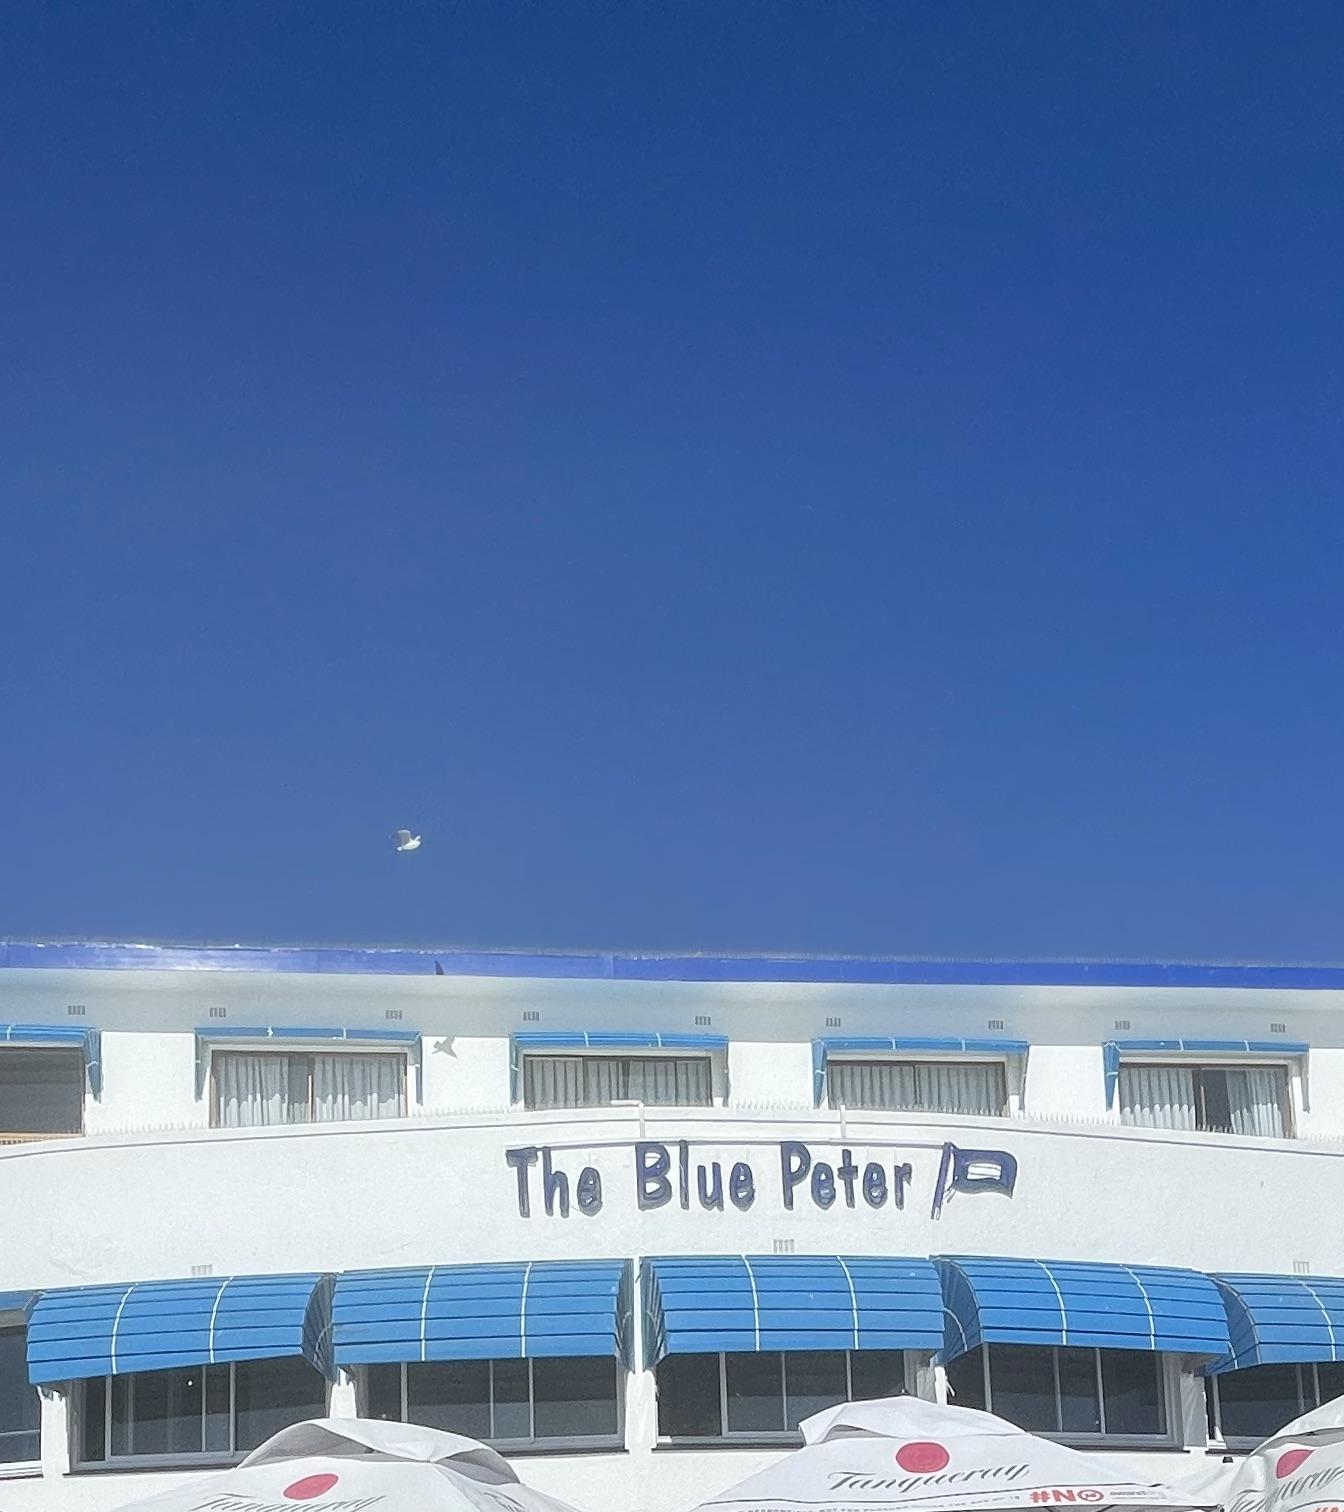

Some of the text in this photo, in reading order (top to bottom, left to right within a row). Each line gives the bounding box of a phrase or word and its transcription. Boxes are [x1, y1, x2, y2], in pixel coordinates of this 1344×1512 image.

[506, 1140, 912, 1218] The Blue Peter
[827, 1464, 1030, 1493] Tanqueray
[1029, 1489, 1104, 1503] #NO
